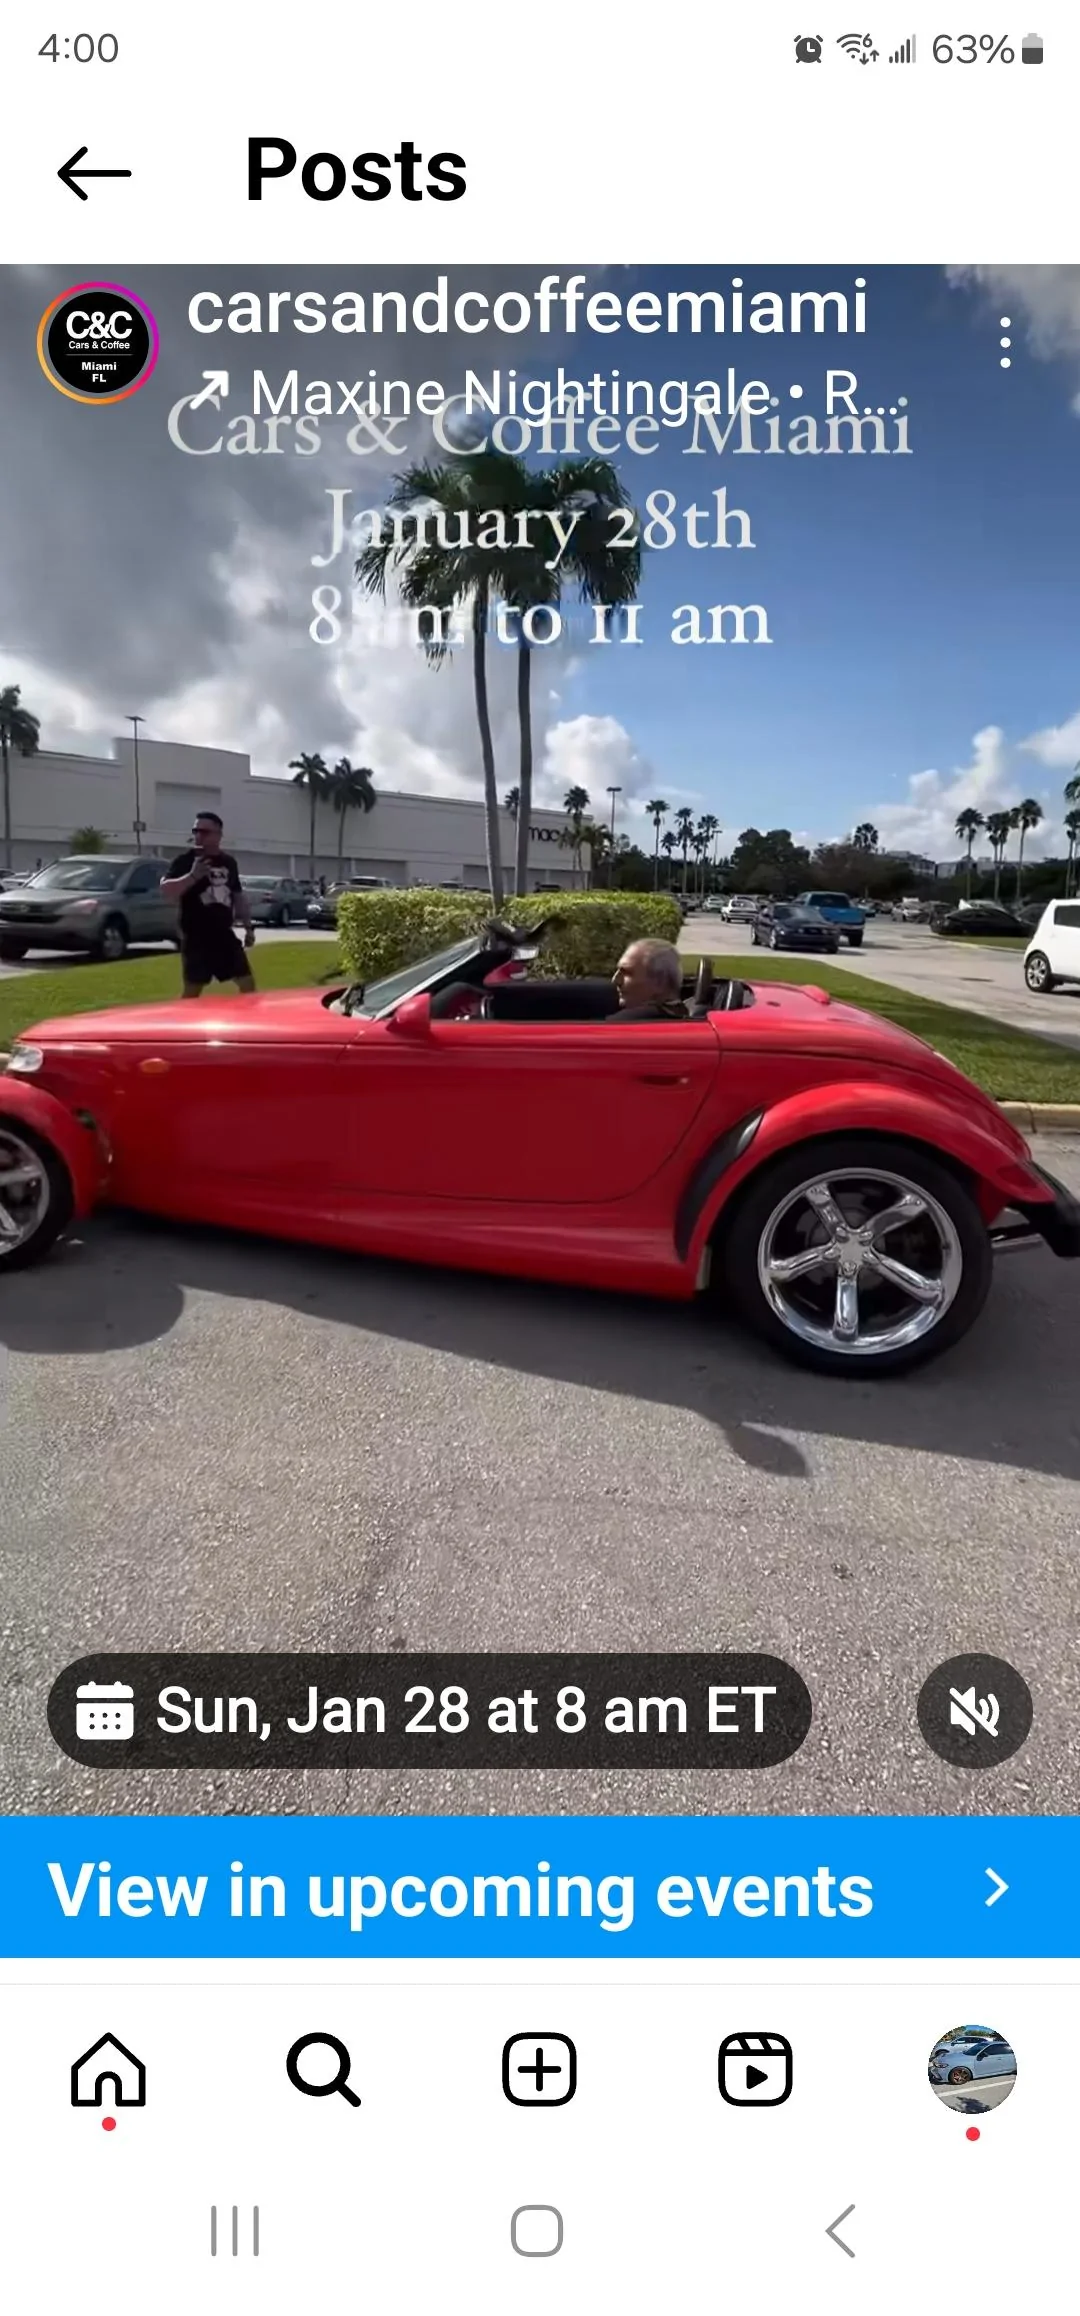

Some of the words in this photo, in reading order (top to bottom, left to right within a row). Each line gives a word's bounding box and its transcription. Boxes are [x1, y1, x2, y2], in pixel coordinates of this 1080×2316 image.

[38, 33, 119, 63] 4:00
[932, 34, 1015, 64] 63%
[247, 136, 468, 202] Posts
[47, 1861, 209, 1917] View
[231, 1861, 285, 1917] in
[309, 1861, 634, 1932] upcoming
[657, 1867, 873, 1917] events
